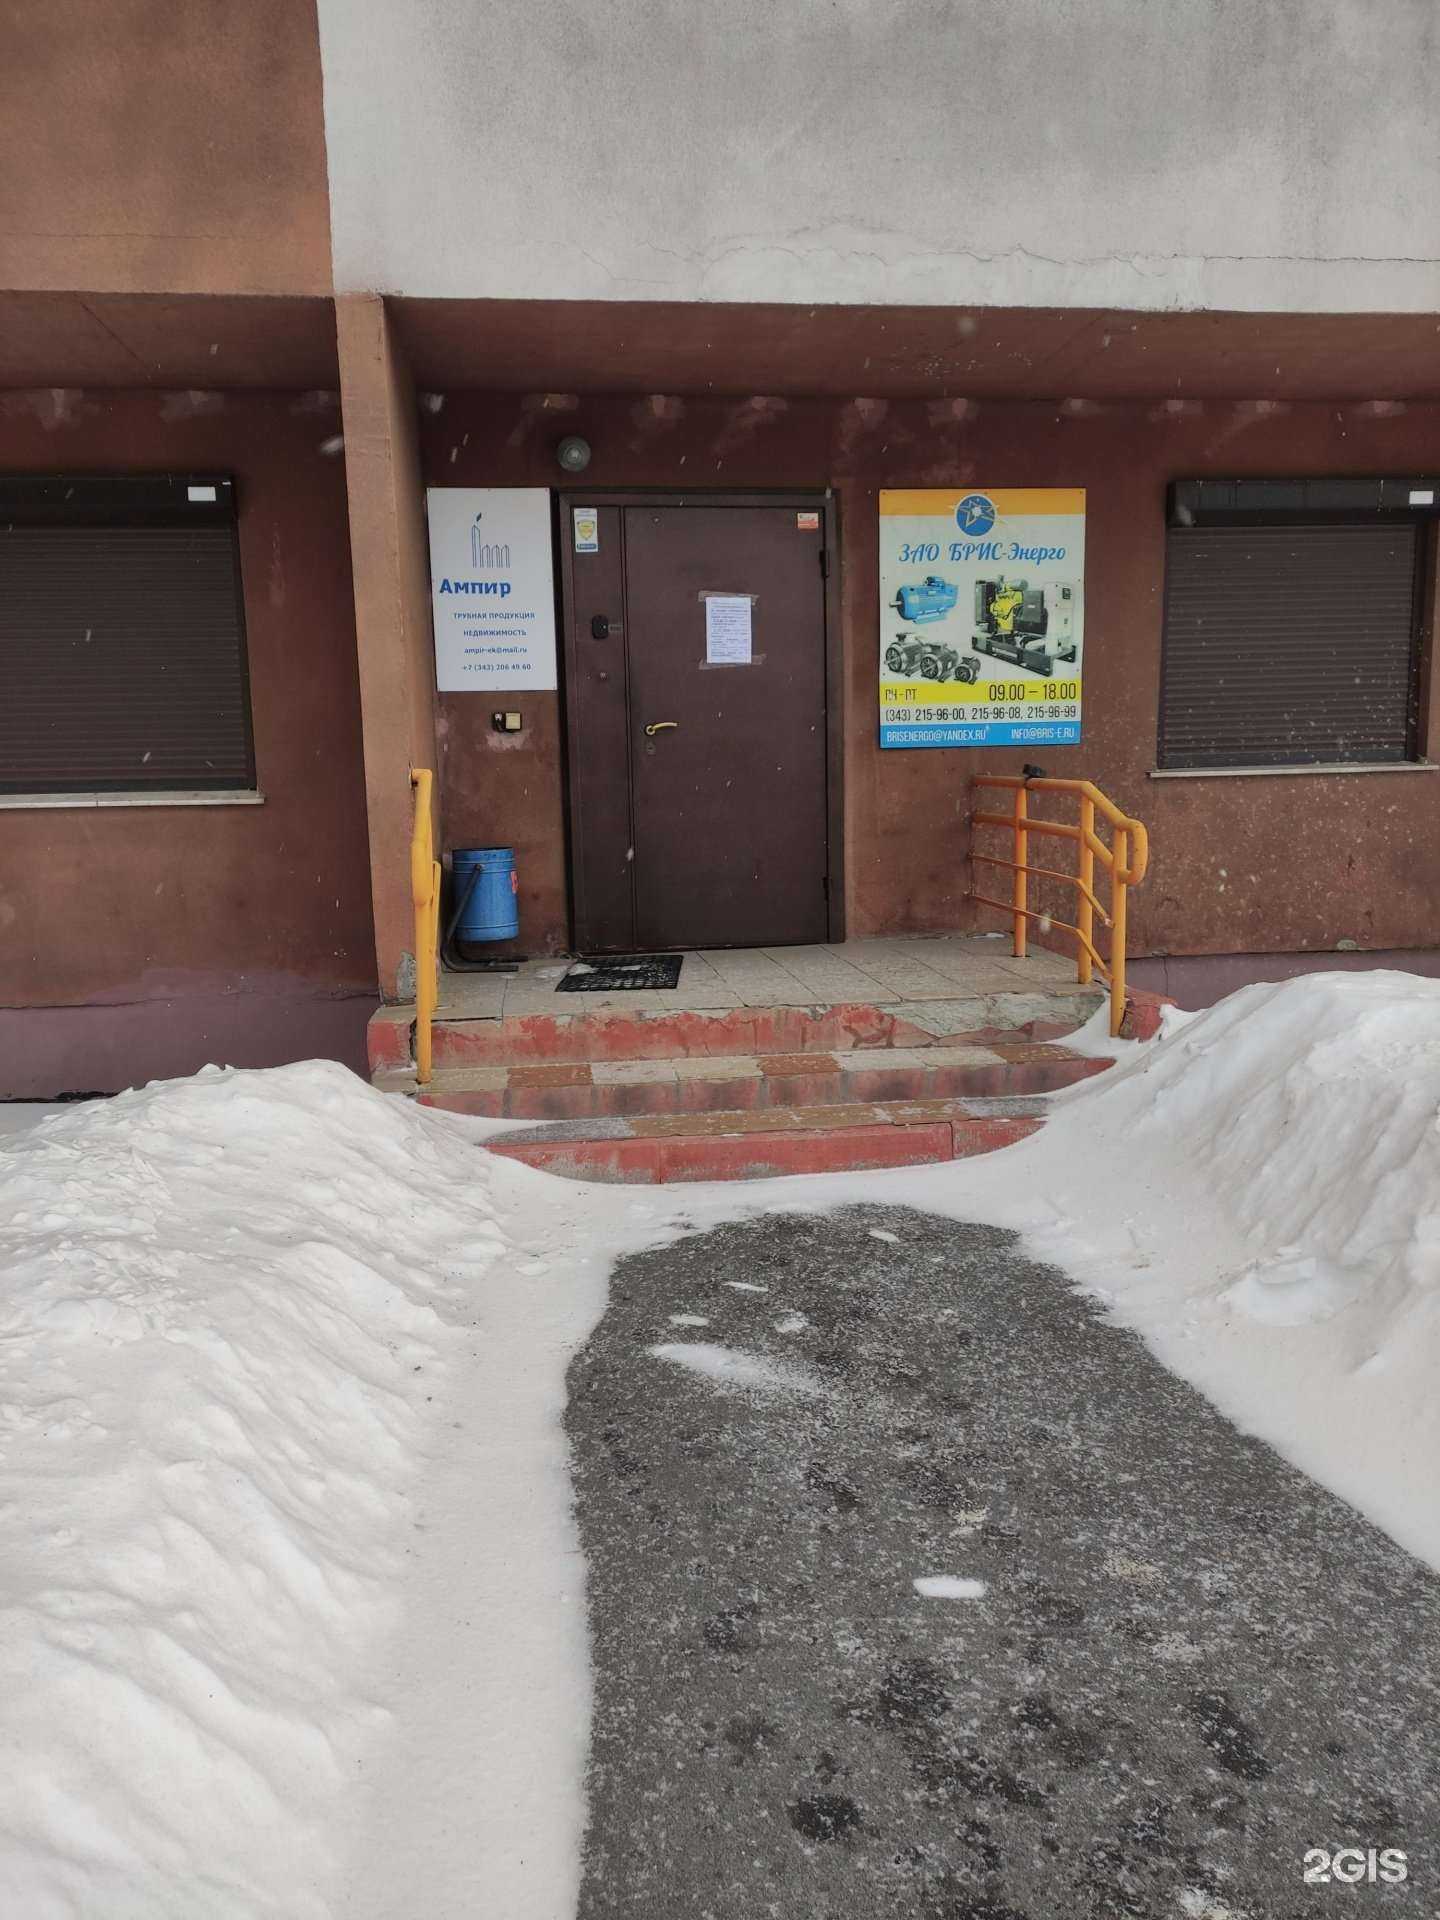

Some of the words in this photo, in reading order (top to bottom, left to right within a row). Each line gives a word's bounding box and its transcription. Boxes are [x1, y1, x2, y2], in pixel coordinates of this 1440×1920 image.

[898, 543, 940, 564] ЗАО
[949, 542, 1067, 566] БРИС-Энерго
[439, 578, 512, 598] Ампир
[453, 611, 487, 619] ТРУБНАЯ
[489, 611, 535, 620] ПРОДУКЦИЯ
[463, 629, 527, 638] НЕДВИЖИМОСТЬ
[474, 663, 495, 672] (343)
[496, 663, 510, 671] 206
[989, 684, 1025, 701] 09.00
[1042, 682, 1077, 700] 18.00
[885, 708, 911, 722] (343)
[915, 707, 967, 721] 215-96-00,
[971, 706, 1023, 720] 215-96-08,
[1027, 705, 1077, 719] 215-96-99
[887, 729, 986, 742] BRISENERGO@YANDEX.RU
[1011, 727, 1075, 740] INFO@BRIS-E.RU
